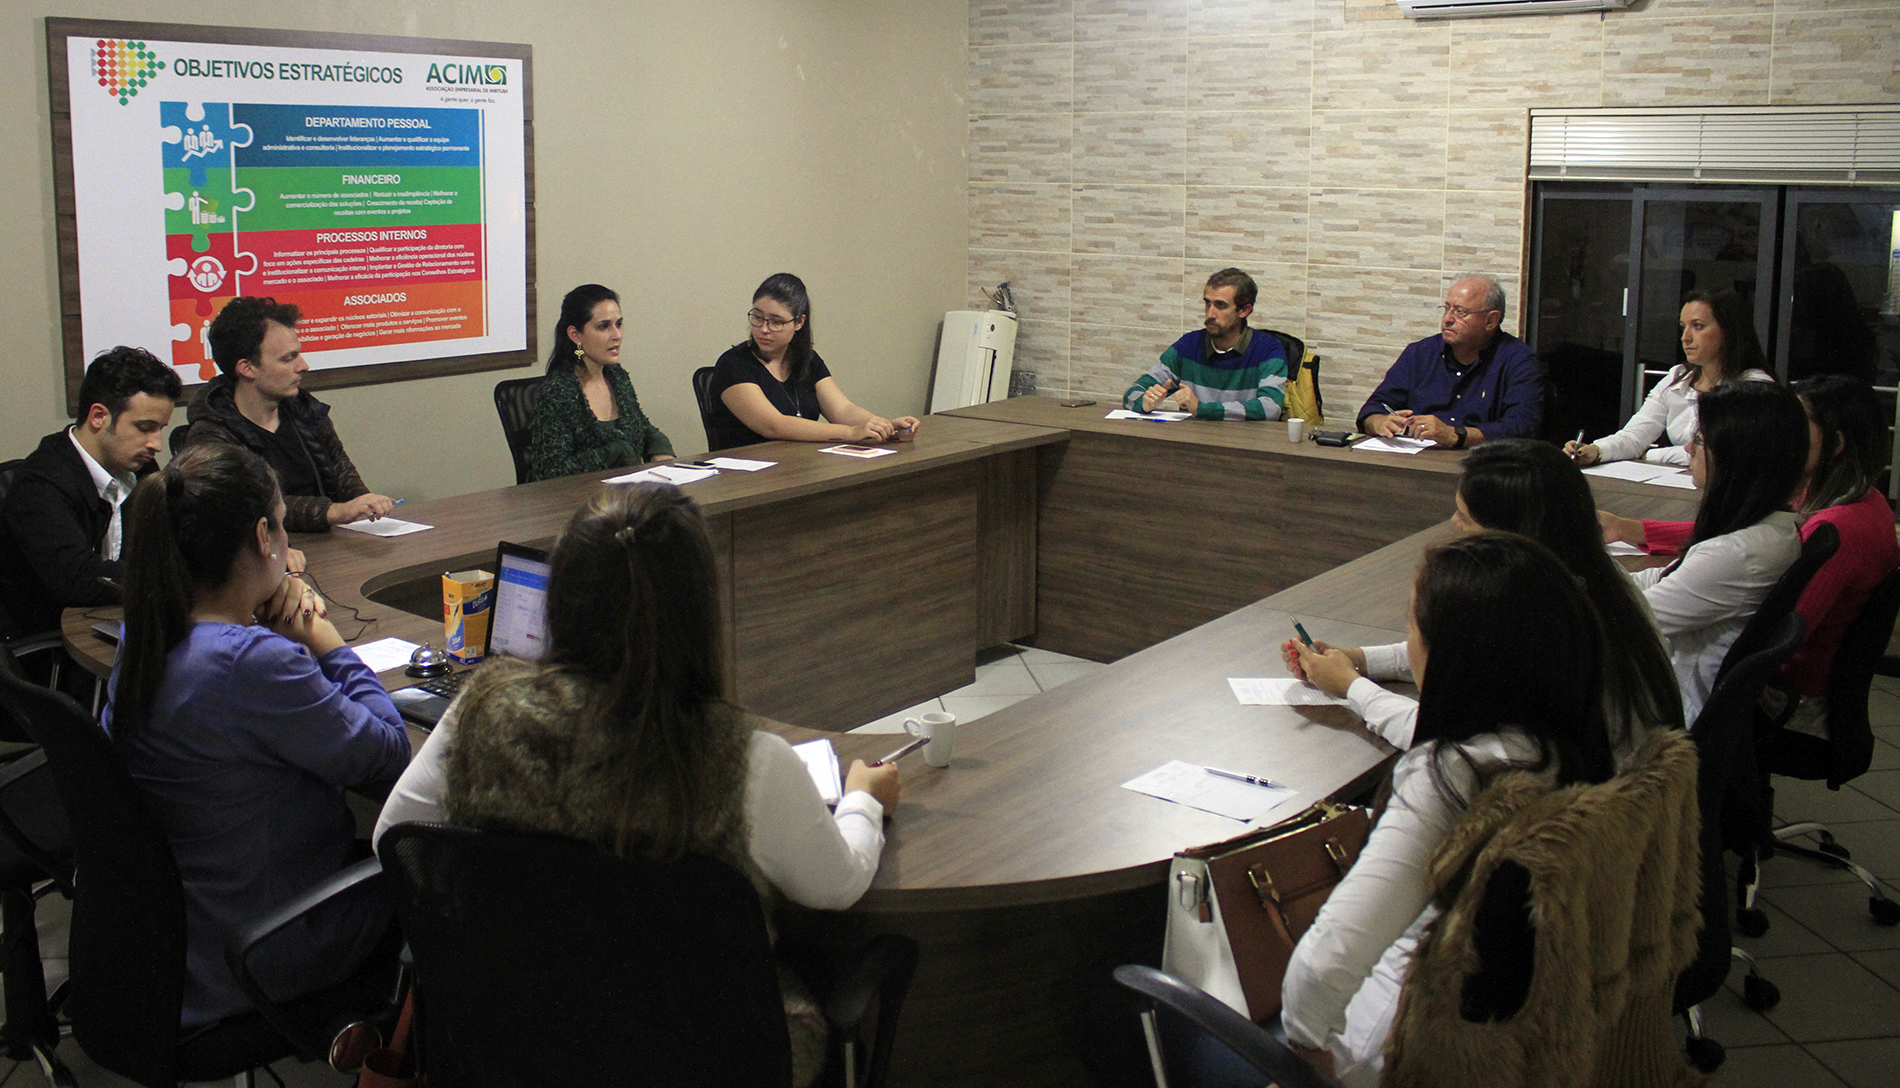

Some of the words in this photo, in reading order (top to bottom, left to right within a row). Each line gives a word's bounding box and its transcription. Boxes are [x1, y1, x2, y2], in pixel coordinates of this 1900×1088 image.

[174, 58, 274, 79] OBJETIVOS
[279, 61, 402, 84] ESTRATÉGICOS
[426, 63, 483, 85] ACIM
[305, 117, 385, 128] DEPARTAMENTO
[387, 118, 432, 129] PESSOAL
[342, 174, 401, 184] FINANCEIRO
[317, 231, 378, 243] PROCESSOS
[380, 230, 427, 241] INTERNOS
[382, 271, 411, 279] participação
[344, 292, 407, 306] ASSOCIADOS
